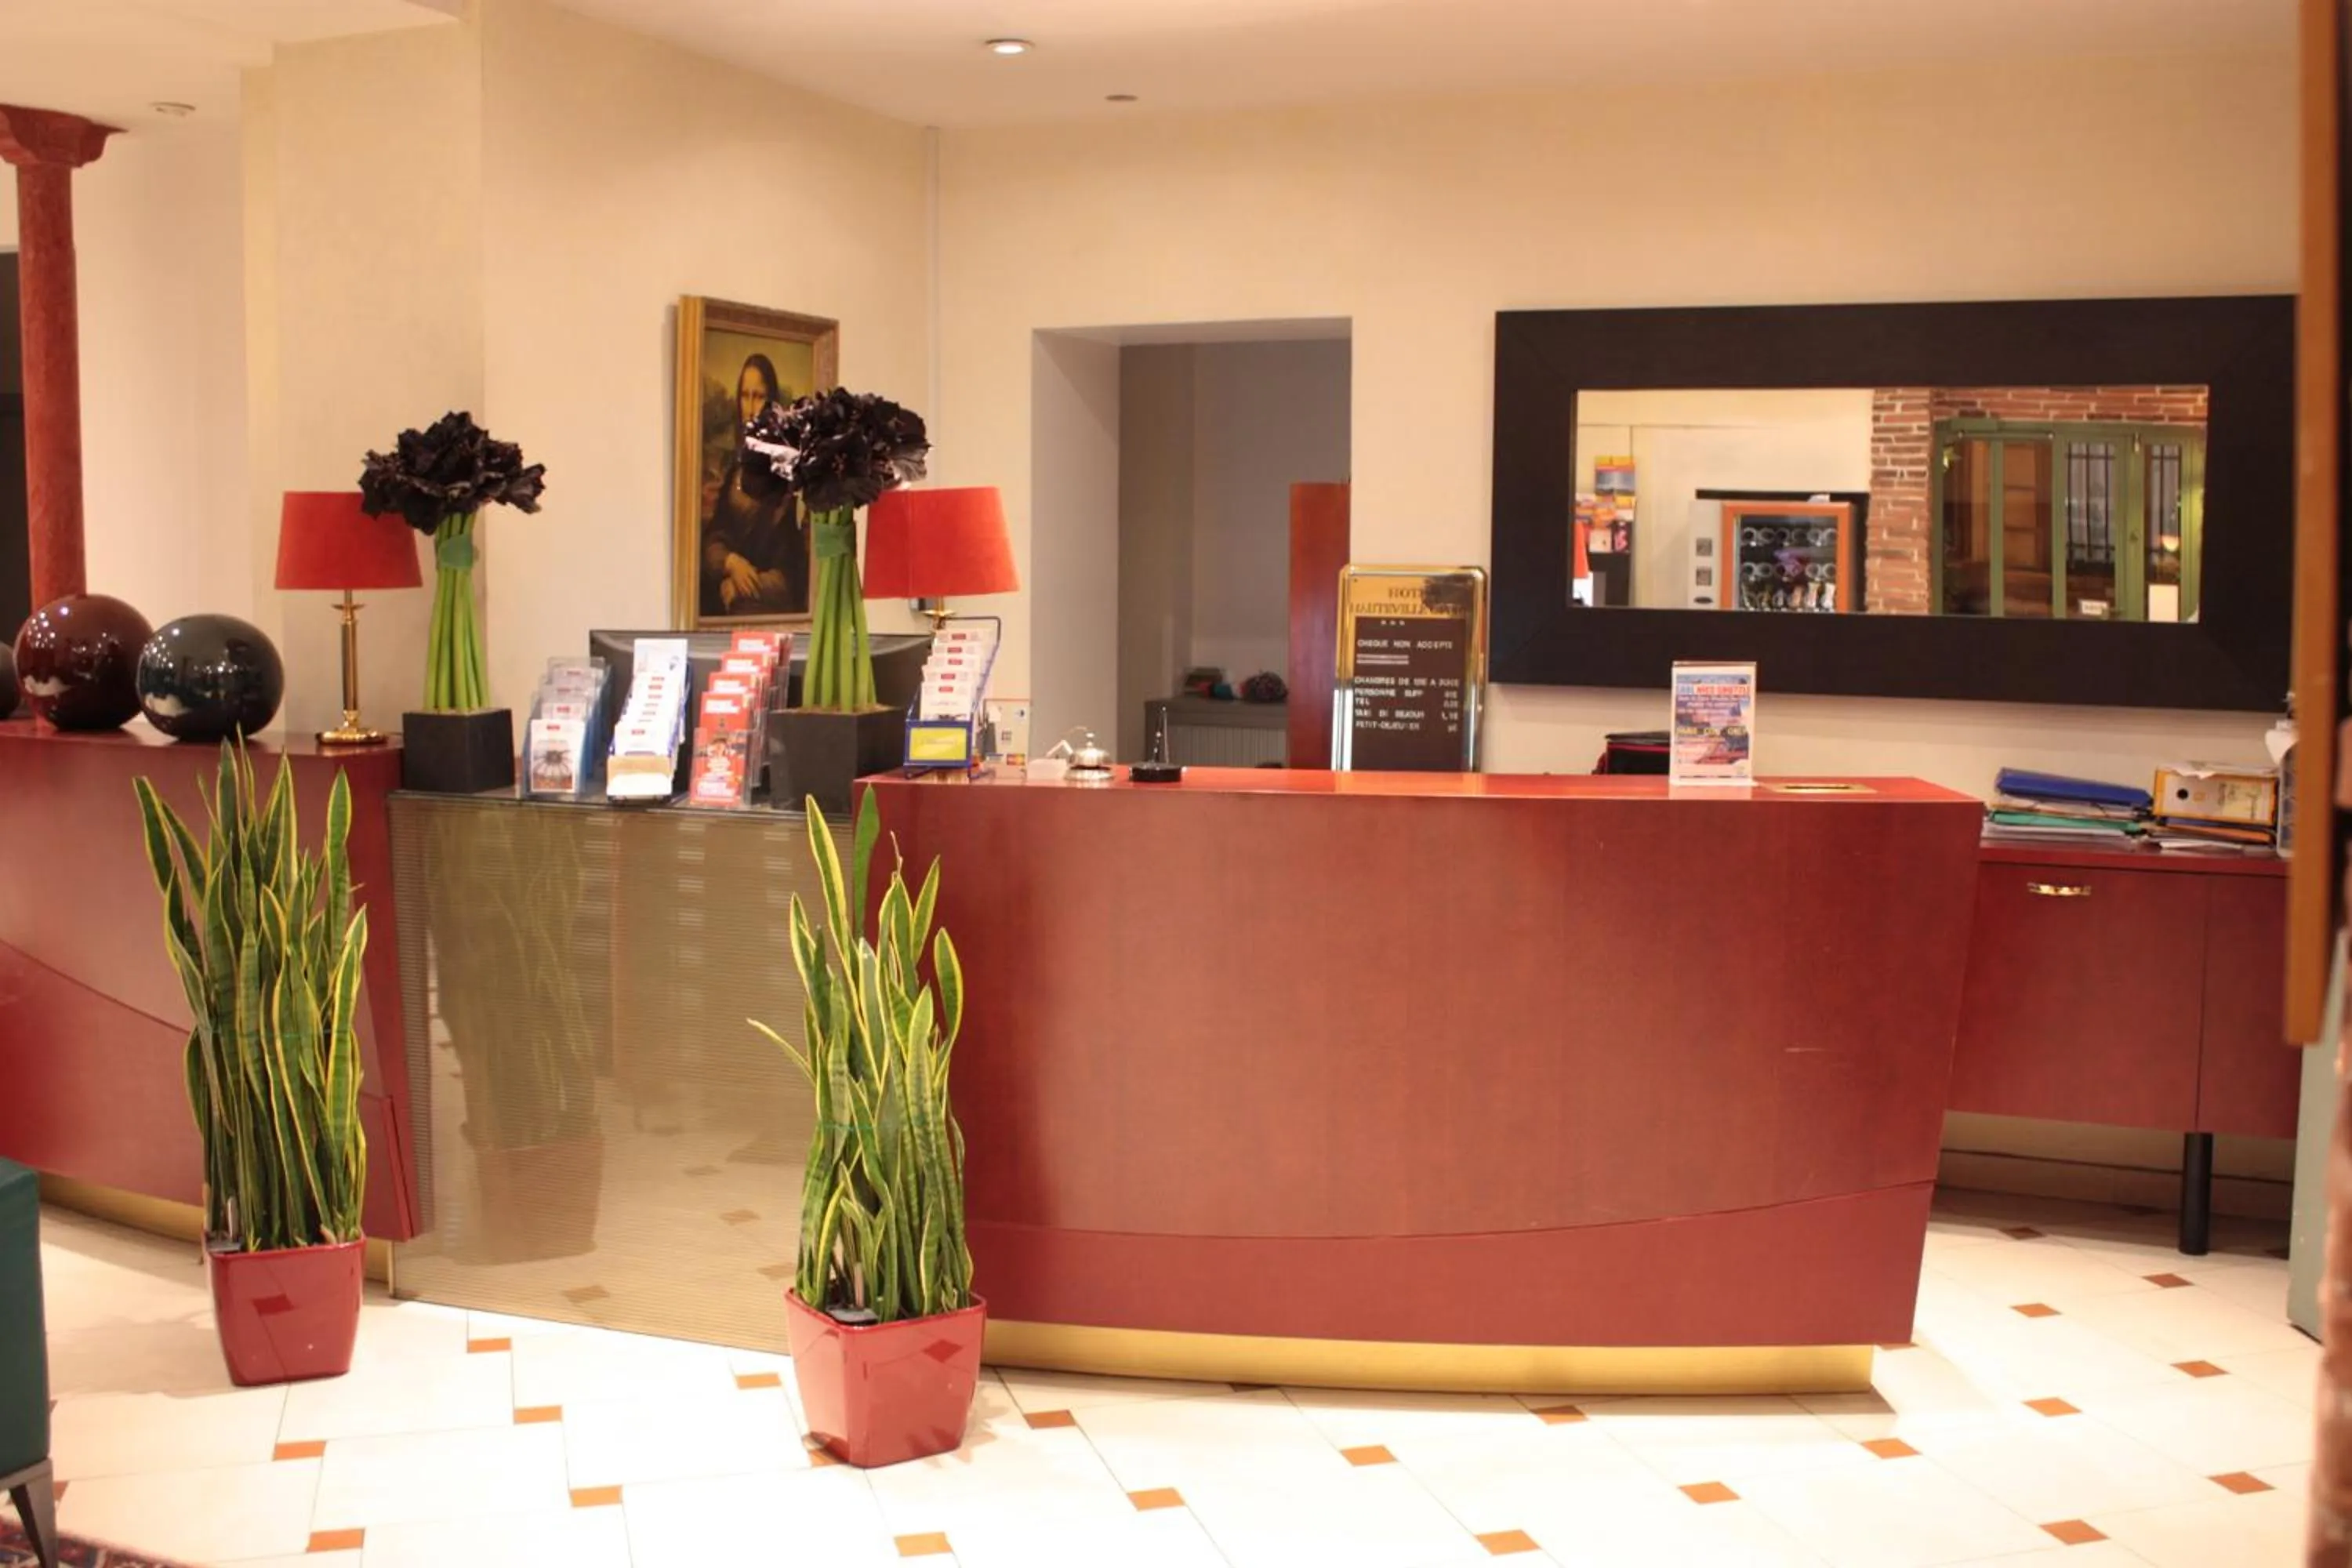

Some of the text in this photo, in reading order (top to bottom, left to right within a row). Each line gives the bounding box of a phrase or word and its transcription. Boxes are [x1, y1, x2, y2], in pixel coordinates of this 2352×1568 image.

[1357, 639, 1388, 648] CHEQUE
[1393, 640, 1410, 649] NON
[1355, 697, 1370, 706] TEL
